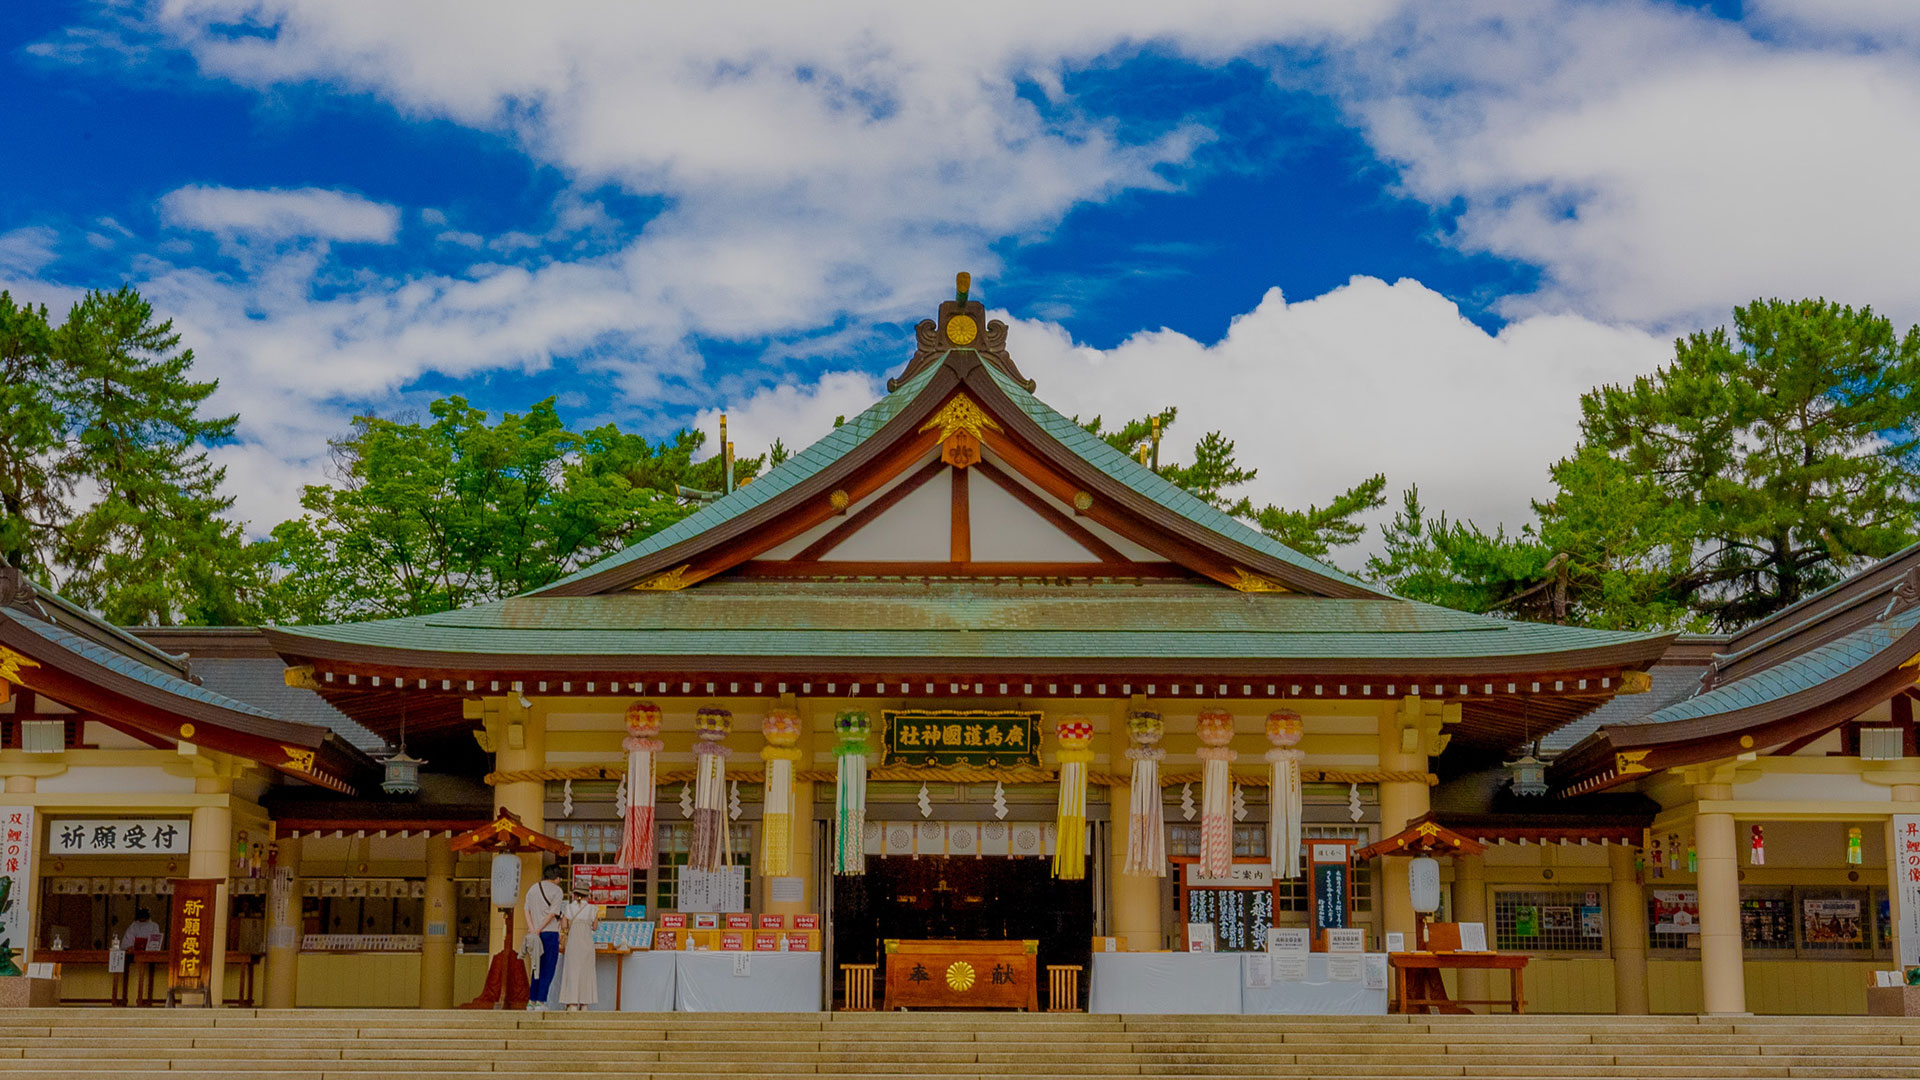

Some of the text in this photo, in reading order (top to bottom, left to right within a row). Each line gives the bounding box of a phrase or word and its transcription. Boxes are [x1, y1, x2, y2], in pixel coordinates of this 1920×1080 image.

[5, 812, 23, 874] 双鯉の像
[60, 823, 179, 850] 祈願受付
[180, 899, 204, 976] 祈願受付
